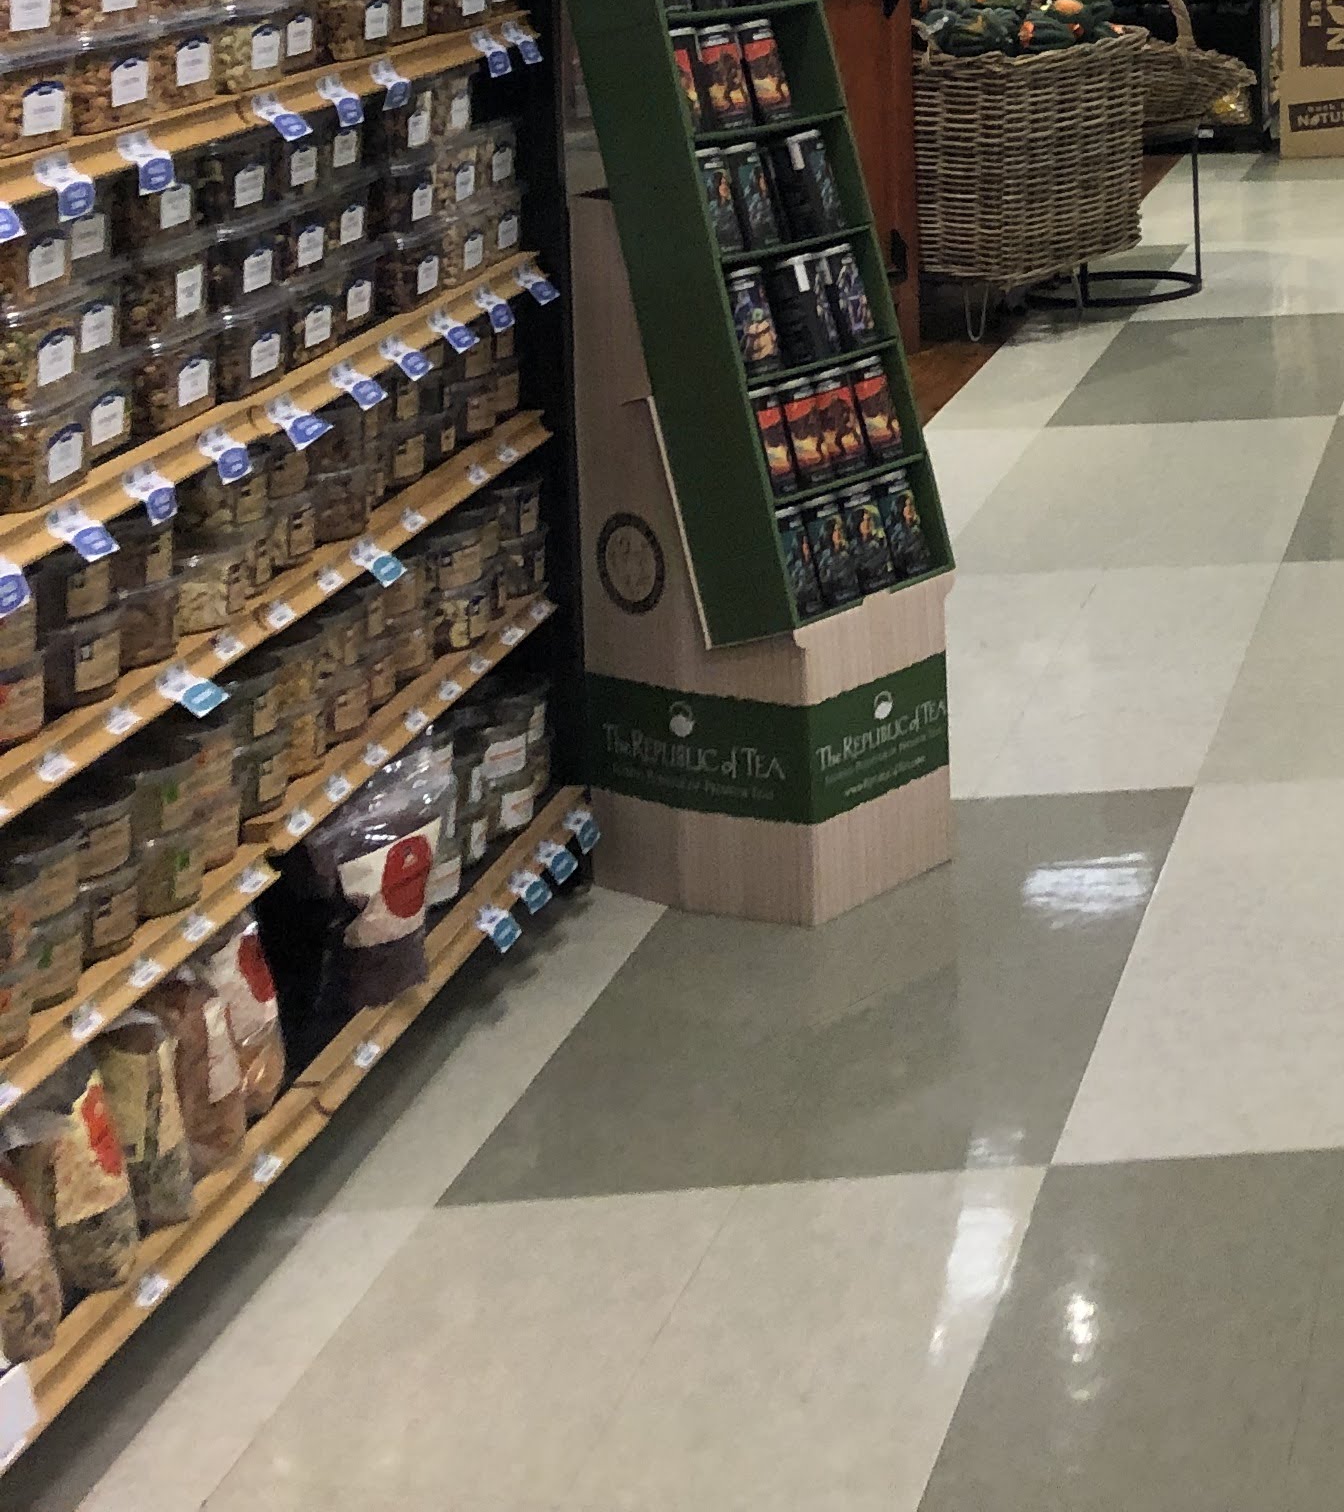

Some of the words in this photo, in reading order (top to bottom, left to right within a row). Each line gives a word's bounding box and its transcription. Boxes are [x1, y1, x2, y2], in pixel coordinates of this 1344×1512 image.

[721, 745, 738, 779] of
[740, 746, 787, 781] TEA
[815, 744, 842, 771] The
[842, 715, 909, 761] REPUBLIC
